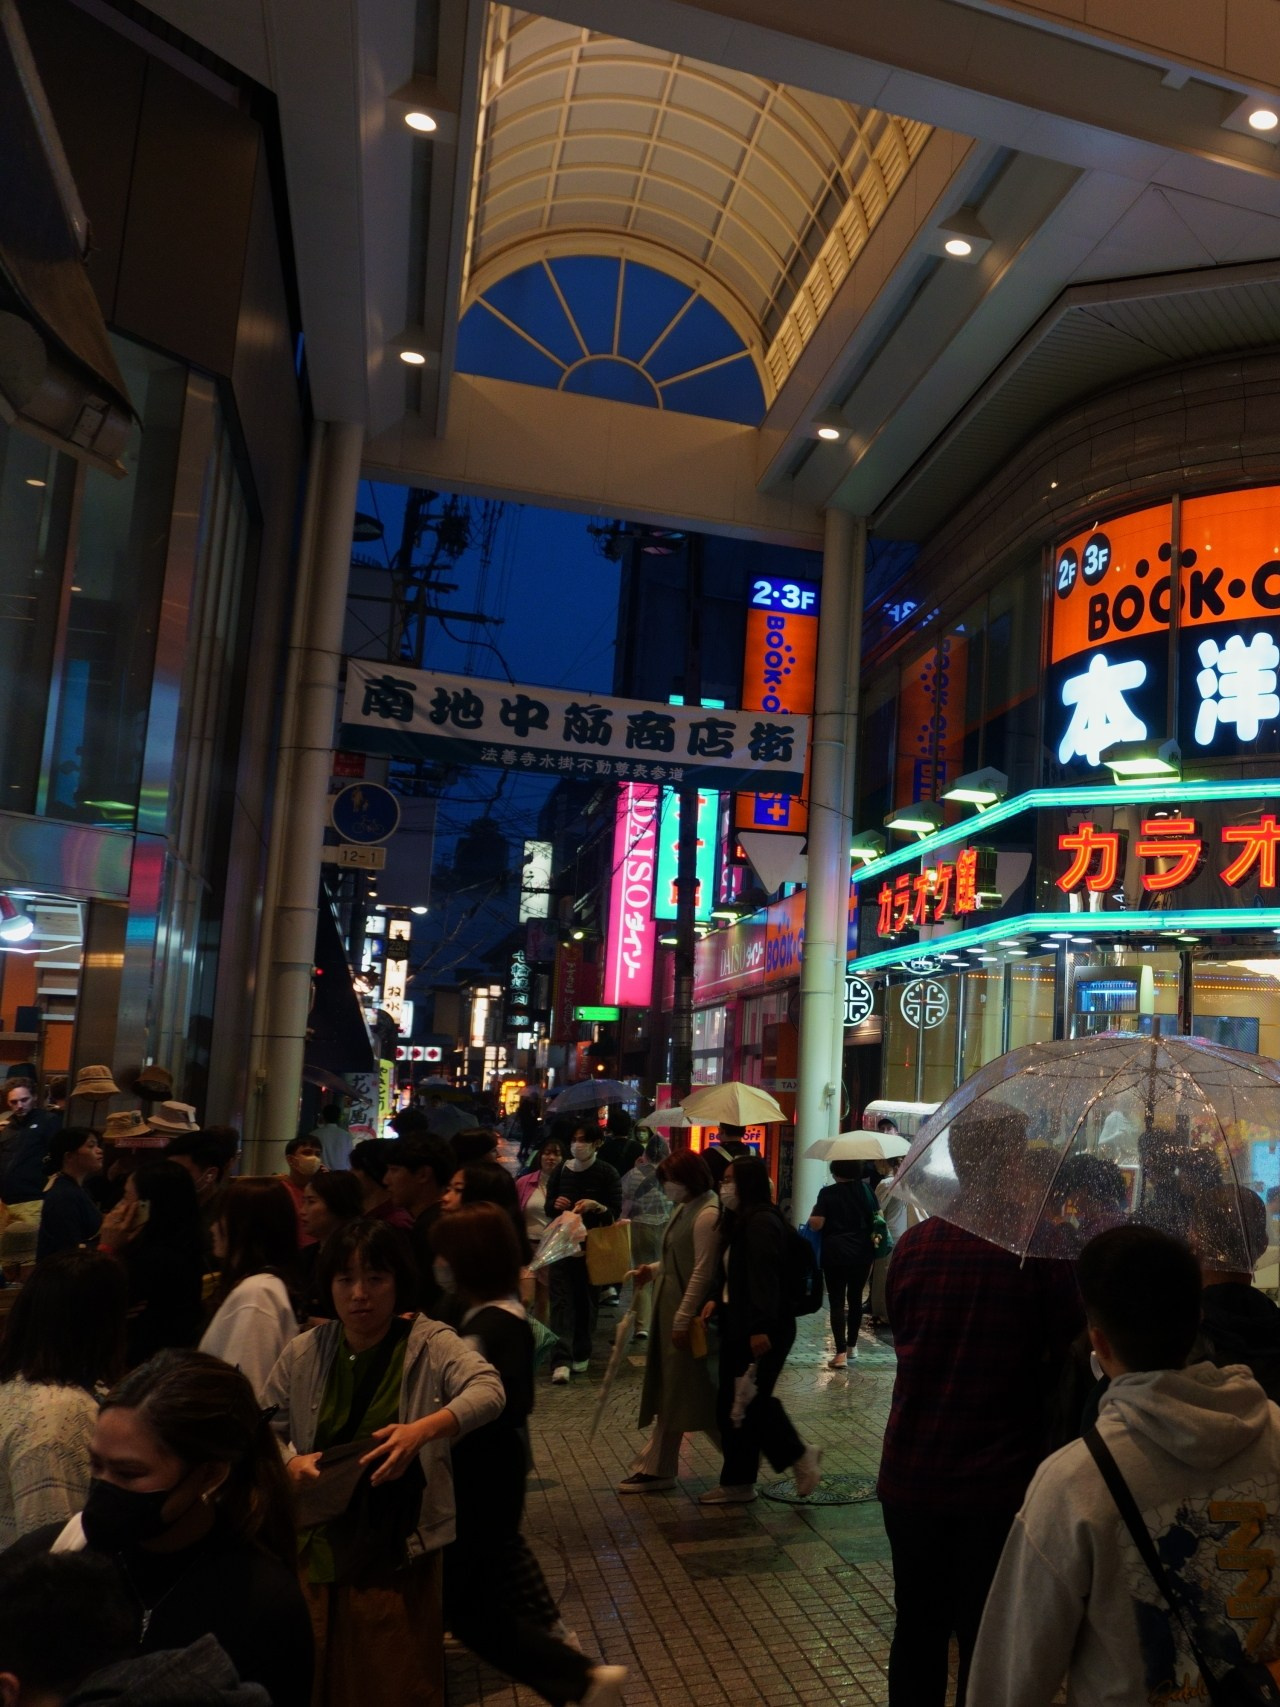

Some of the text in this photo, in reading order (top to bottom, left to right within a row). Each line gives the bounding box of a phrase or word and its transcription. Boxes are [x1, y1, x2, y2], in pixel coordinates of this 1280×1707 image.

[1058, 544, 1109, 592] 2F 3F
[361, 675, 795, 763] 南地中筋商店街
[1058, 653, 1149, 767] 本
[479, 747, 686, 783] 法善寺水掛不動尊表参道
[625, 797, 658, 909] DAISO
[876, 845, 980, 937] カラオケ館
[623, 910, 646, 979] ダイソー
[720, 941, 747, 977] DAISO
